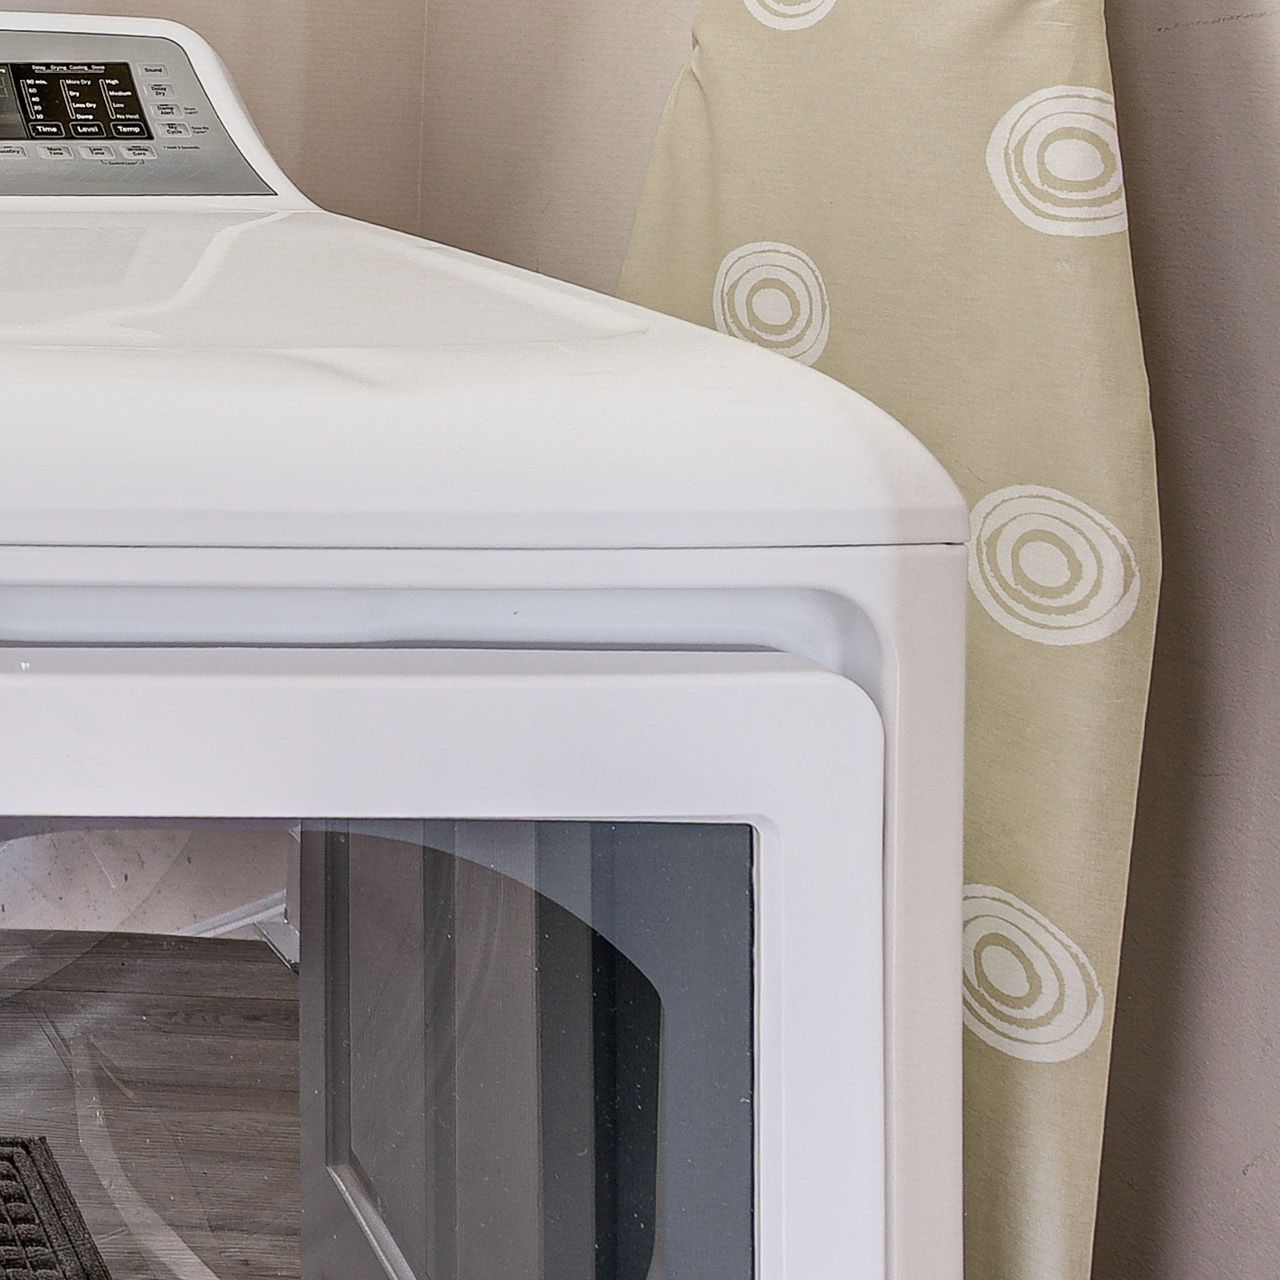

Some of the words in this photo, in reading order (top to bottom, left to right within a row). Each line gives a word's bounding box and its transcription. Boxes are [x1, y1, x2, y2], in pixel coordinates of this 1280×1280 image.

[36, 125, 58, 133] Time
[76, 125, 99, 133] Level
[117, 125, 141, 134] Temp
